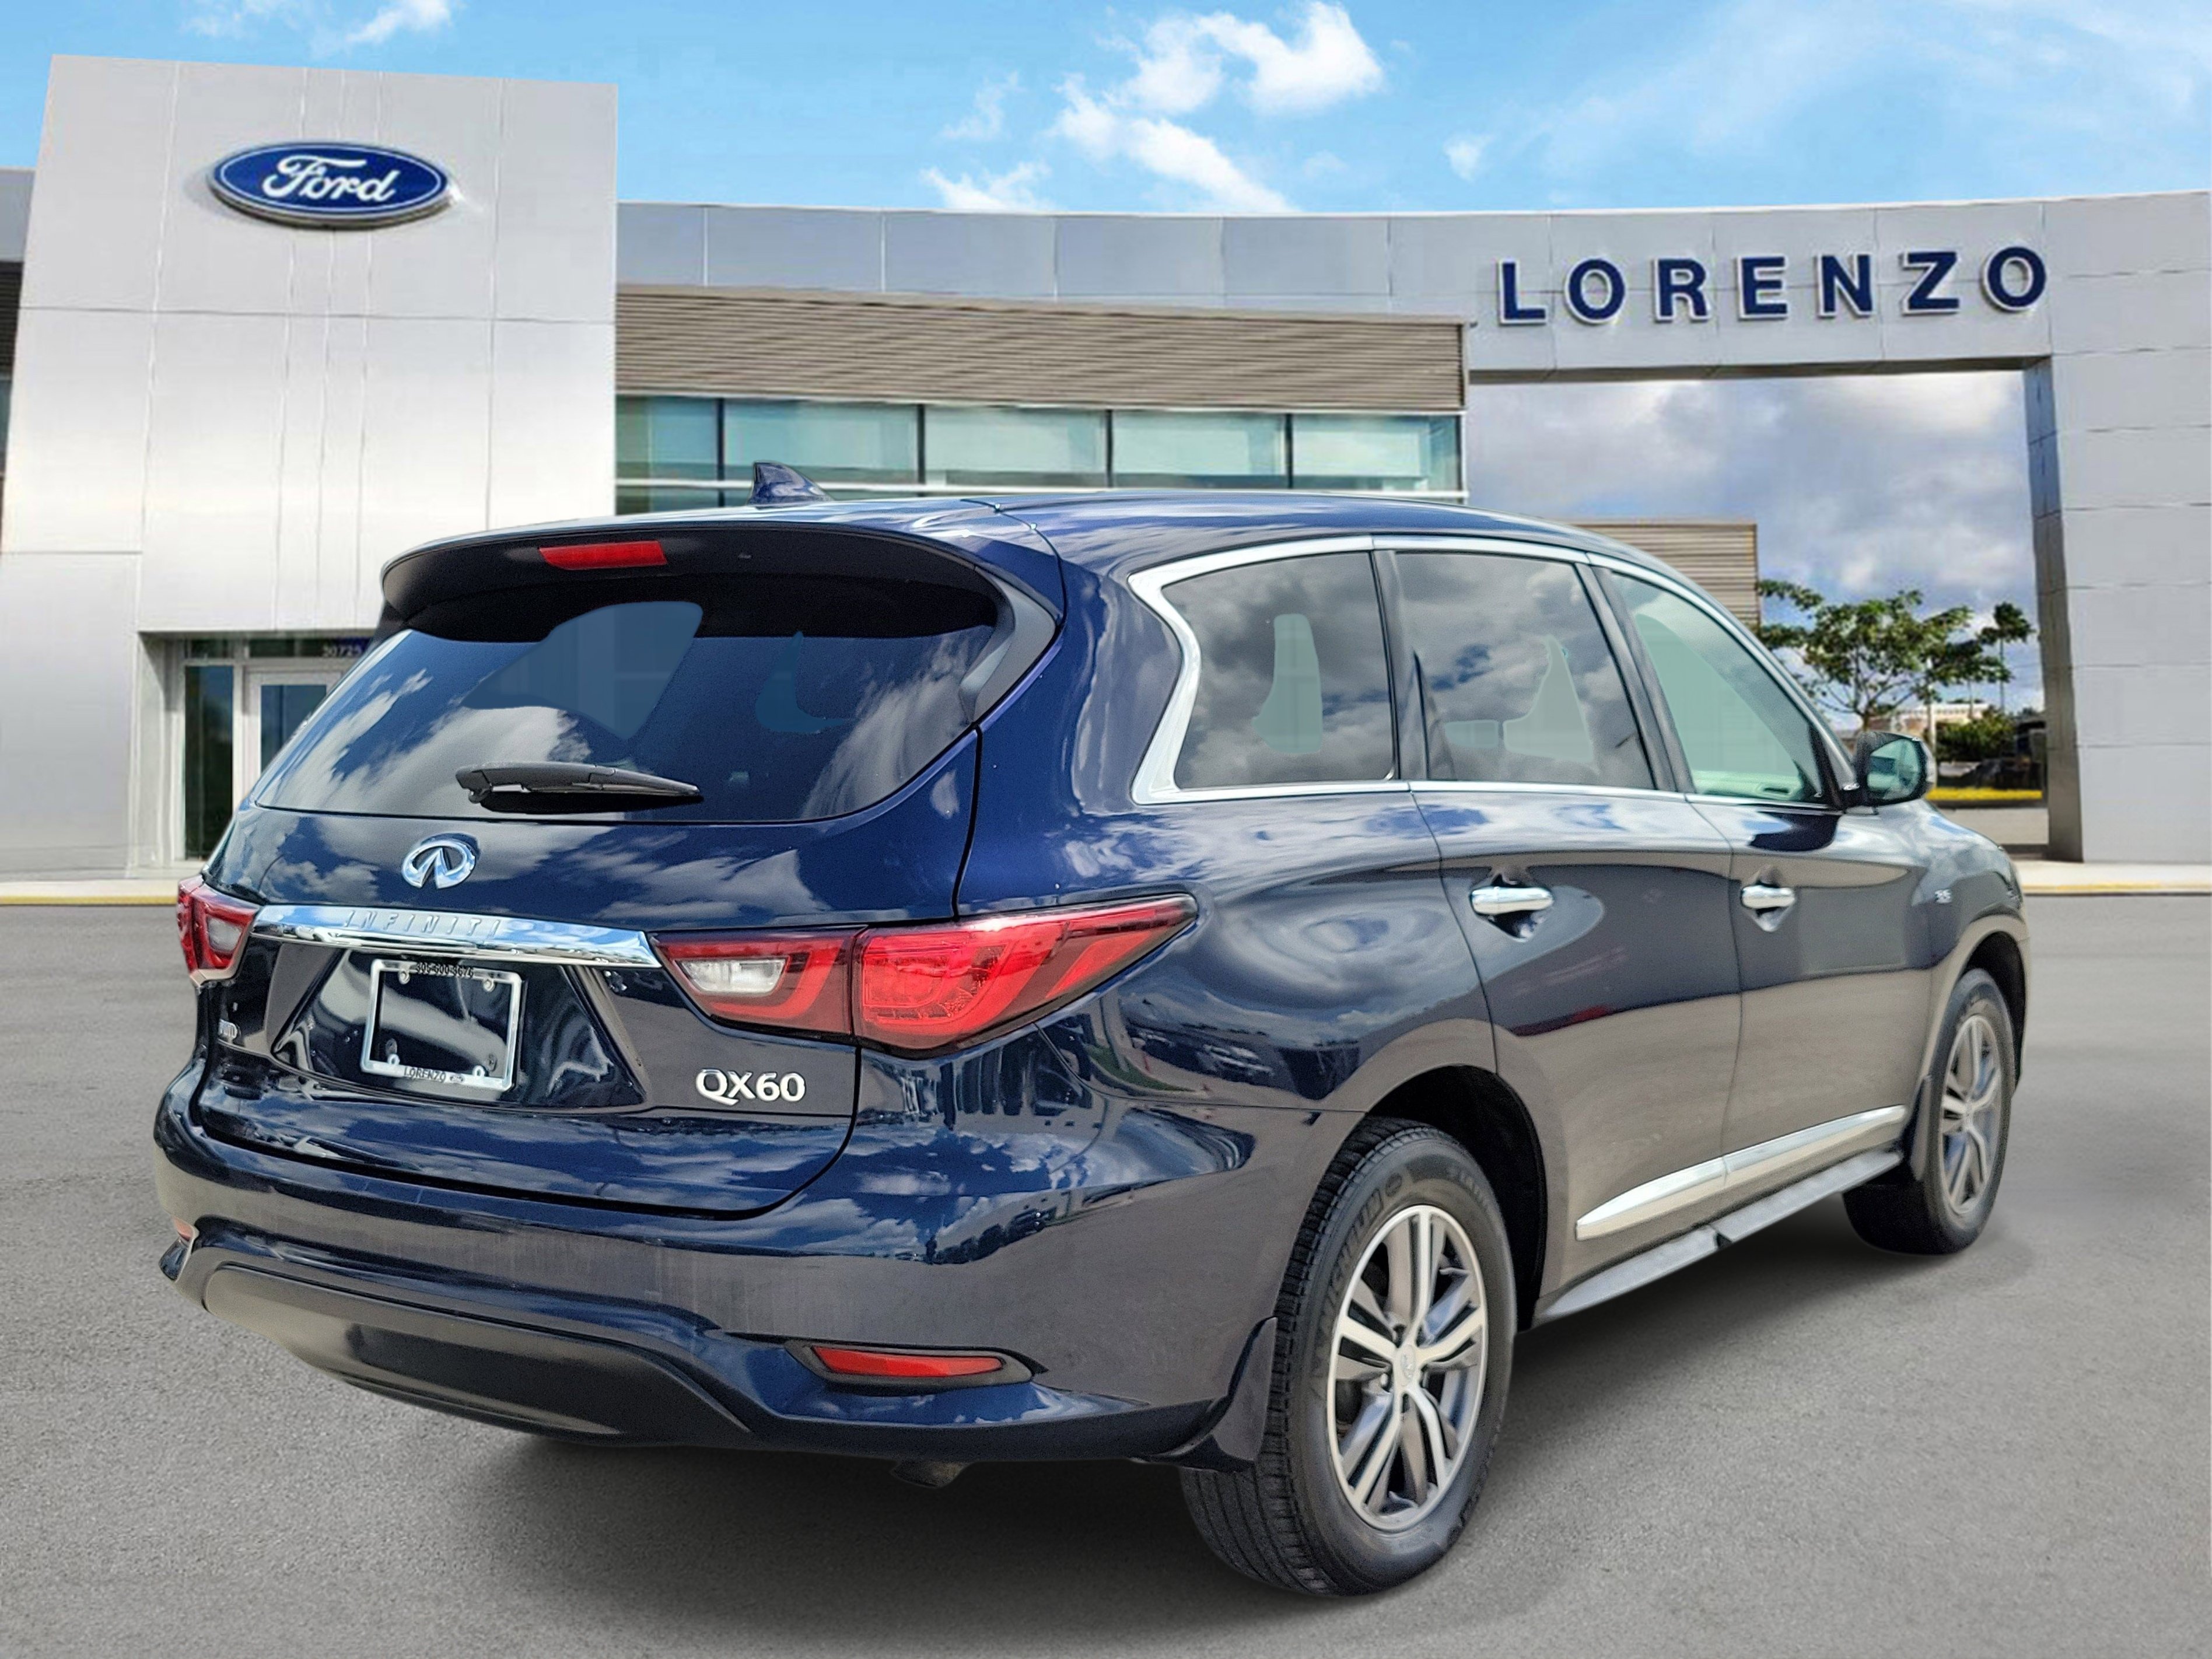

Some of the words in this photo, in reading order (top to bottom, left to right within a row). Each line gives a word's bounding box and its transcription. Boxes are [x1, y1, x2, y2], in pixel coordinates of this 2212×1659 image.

[261, 154, 401, 202] Ford
[1496, 246, 2048, 324] LORENZO
[343, 909, 501, 937] INFINITI
[404, 1066, 447, 1083] LORENZO
[695, 1068, 806, 1106] QX60
